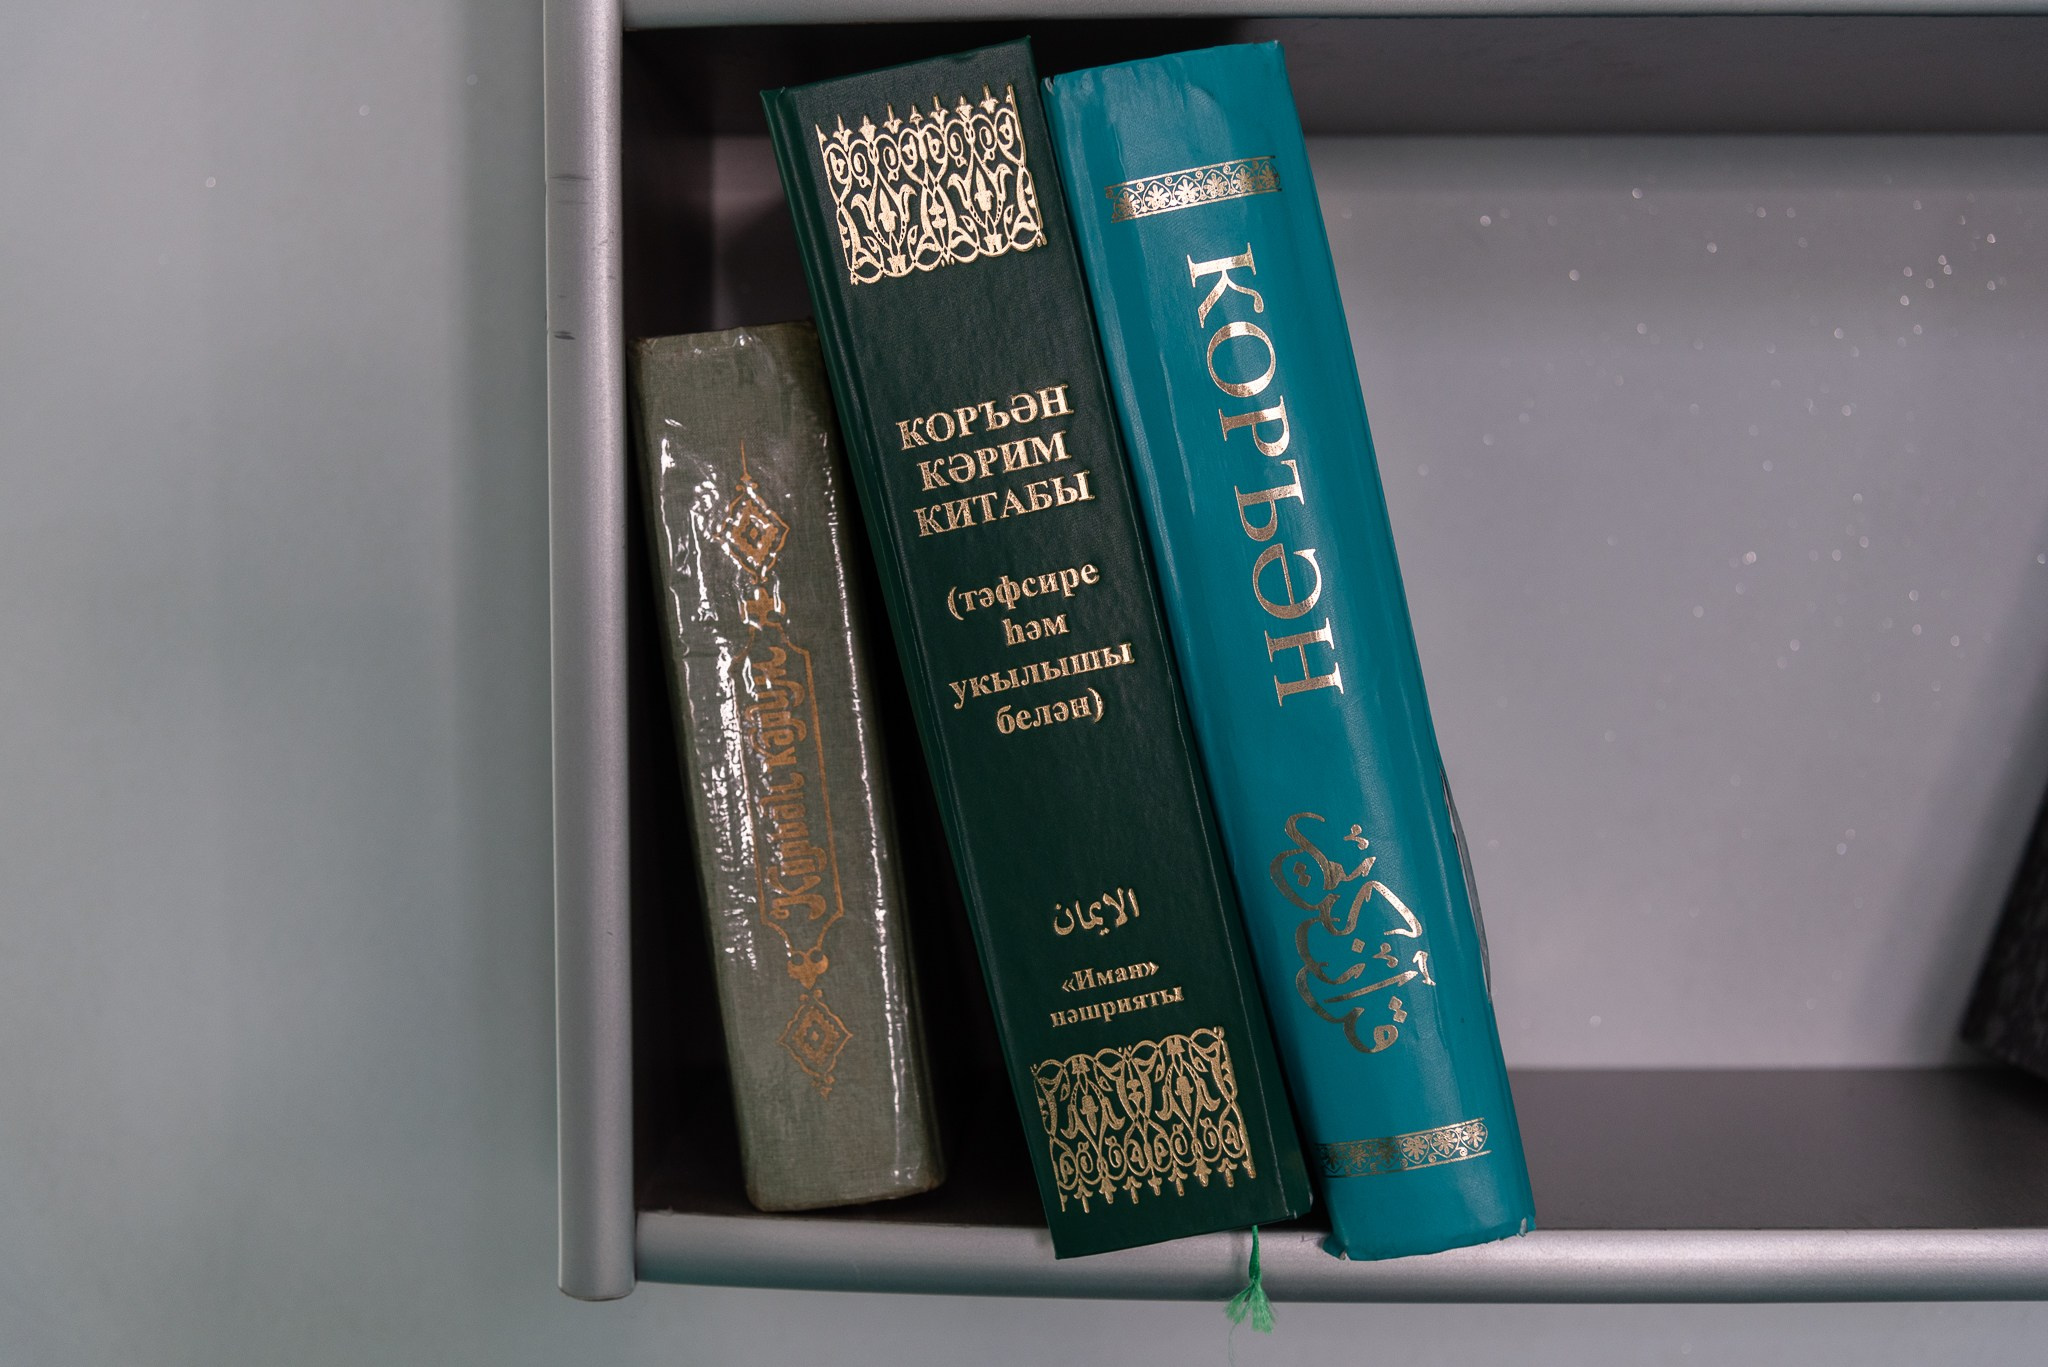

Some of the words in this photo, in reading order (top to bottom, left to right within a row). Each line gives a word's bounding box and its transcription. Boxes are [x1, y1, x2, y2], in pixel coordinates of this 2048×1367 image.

[896, 384, 1074, 450] КОРЪӘН
[917, 431, 1071, 491] КӘРИМ
[1185, 244, 1344, 705] КОРЪӘН
[914, 471, 1095, 537] КИТАБЫ
[947, 563, 1100, 620] (тәфсире
[1003, 613, 1070, 646] һәм
[949, 642, 1135, 710] укылышы
[996, 688, 1104, 734] белән)
[1062, 962, 1158, 992] «Иман»
[1050, 986, 1184, 1027] нәшрияты
